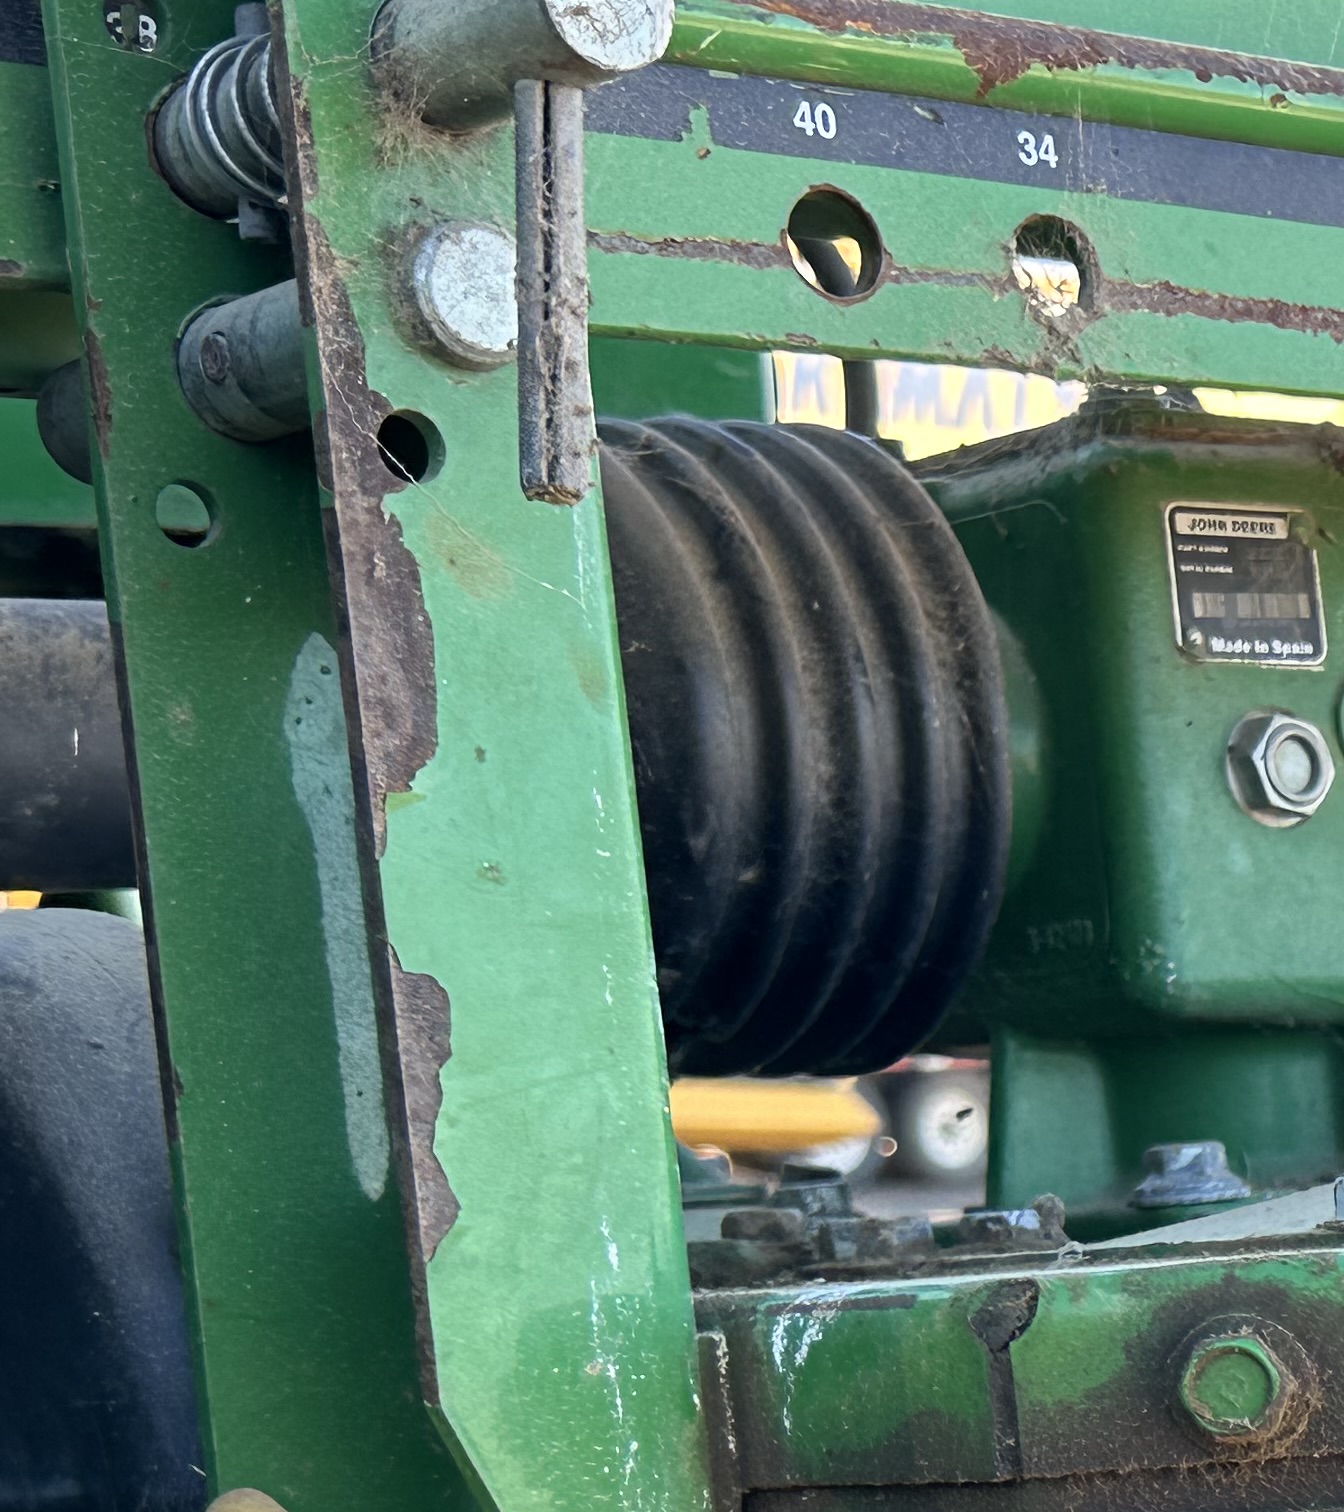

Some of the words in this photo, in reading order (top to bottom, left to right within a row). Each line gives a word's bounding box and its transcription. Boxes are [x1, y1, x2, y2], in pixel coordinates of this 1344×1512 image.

[793, 100, 837, 140] 40
[1016, 129, 1059, 169] 34
[1187, 517, 1228, 533] JOHN
[1231, 520, 1277, 535] DEERE
[1211, 635, 1252, 654] Made
[1271, 639, 1314, 659] Spain
